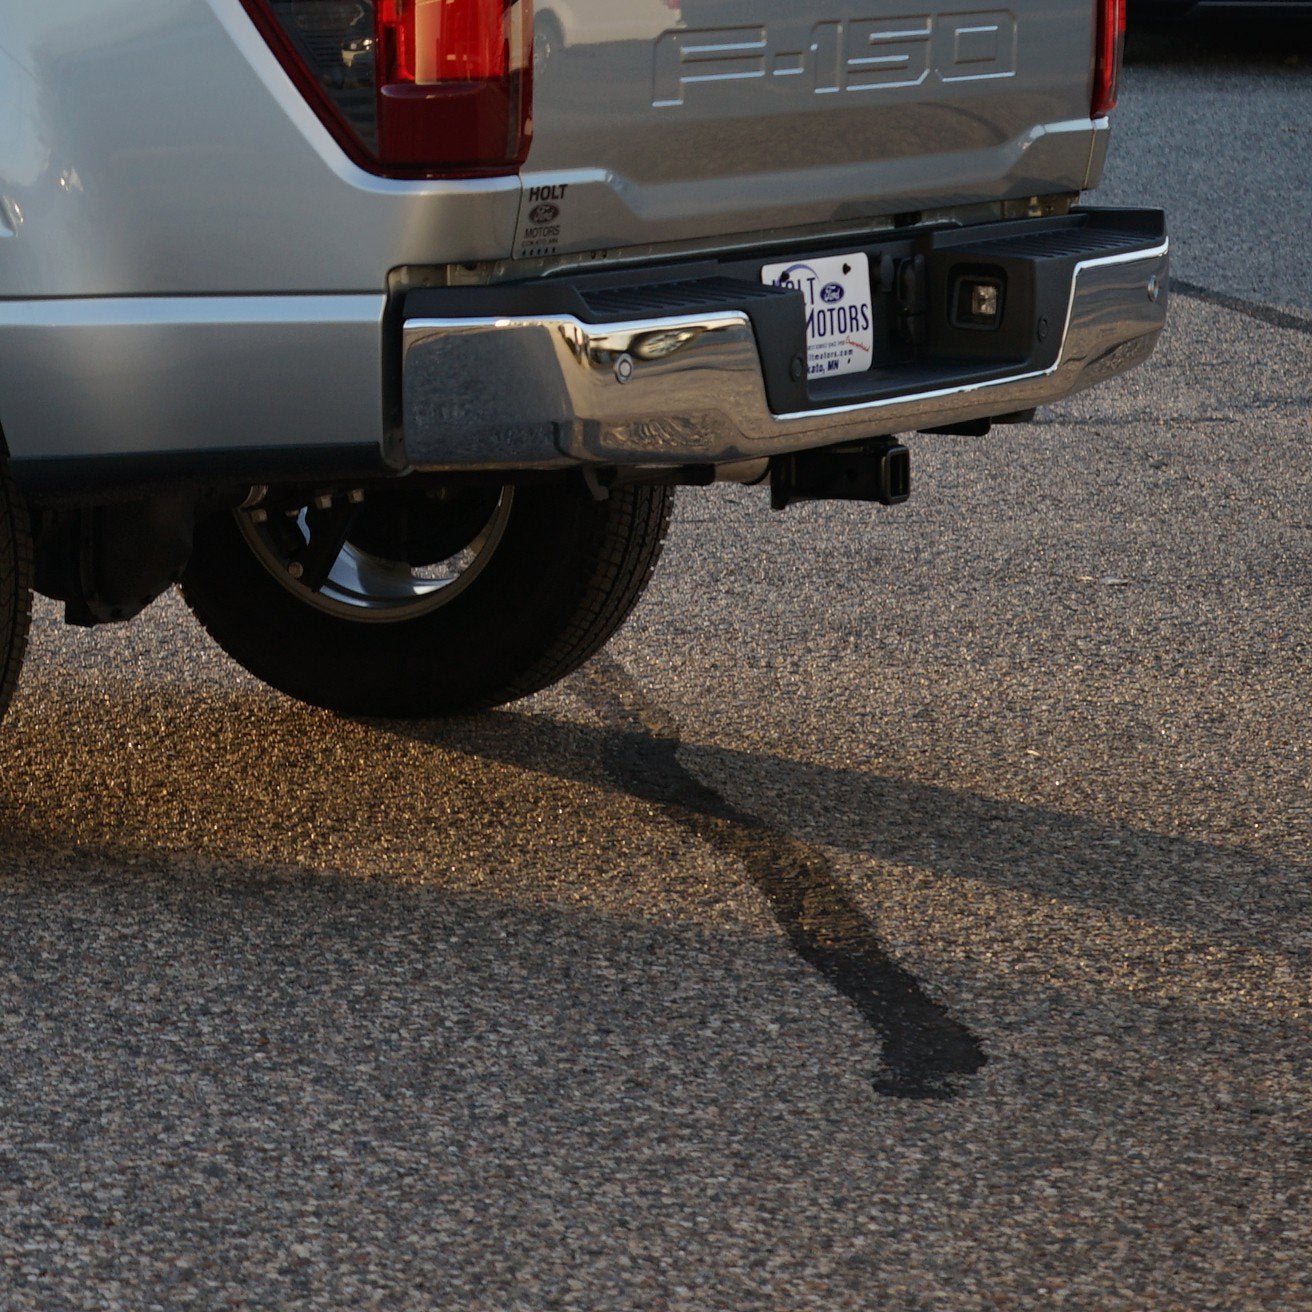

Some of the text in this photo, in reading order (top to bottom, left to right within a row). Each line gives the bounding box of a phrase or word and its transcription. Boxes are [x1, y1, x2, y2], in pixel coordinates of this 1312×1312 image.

[651, 8, 1018, 108] F-150
[529, 184, 568, 202] HOLT
[525, 225, 560, 238] MOTORS
